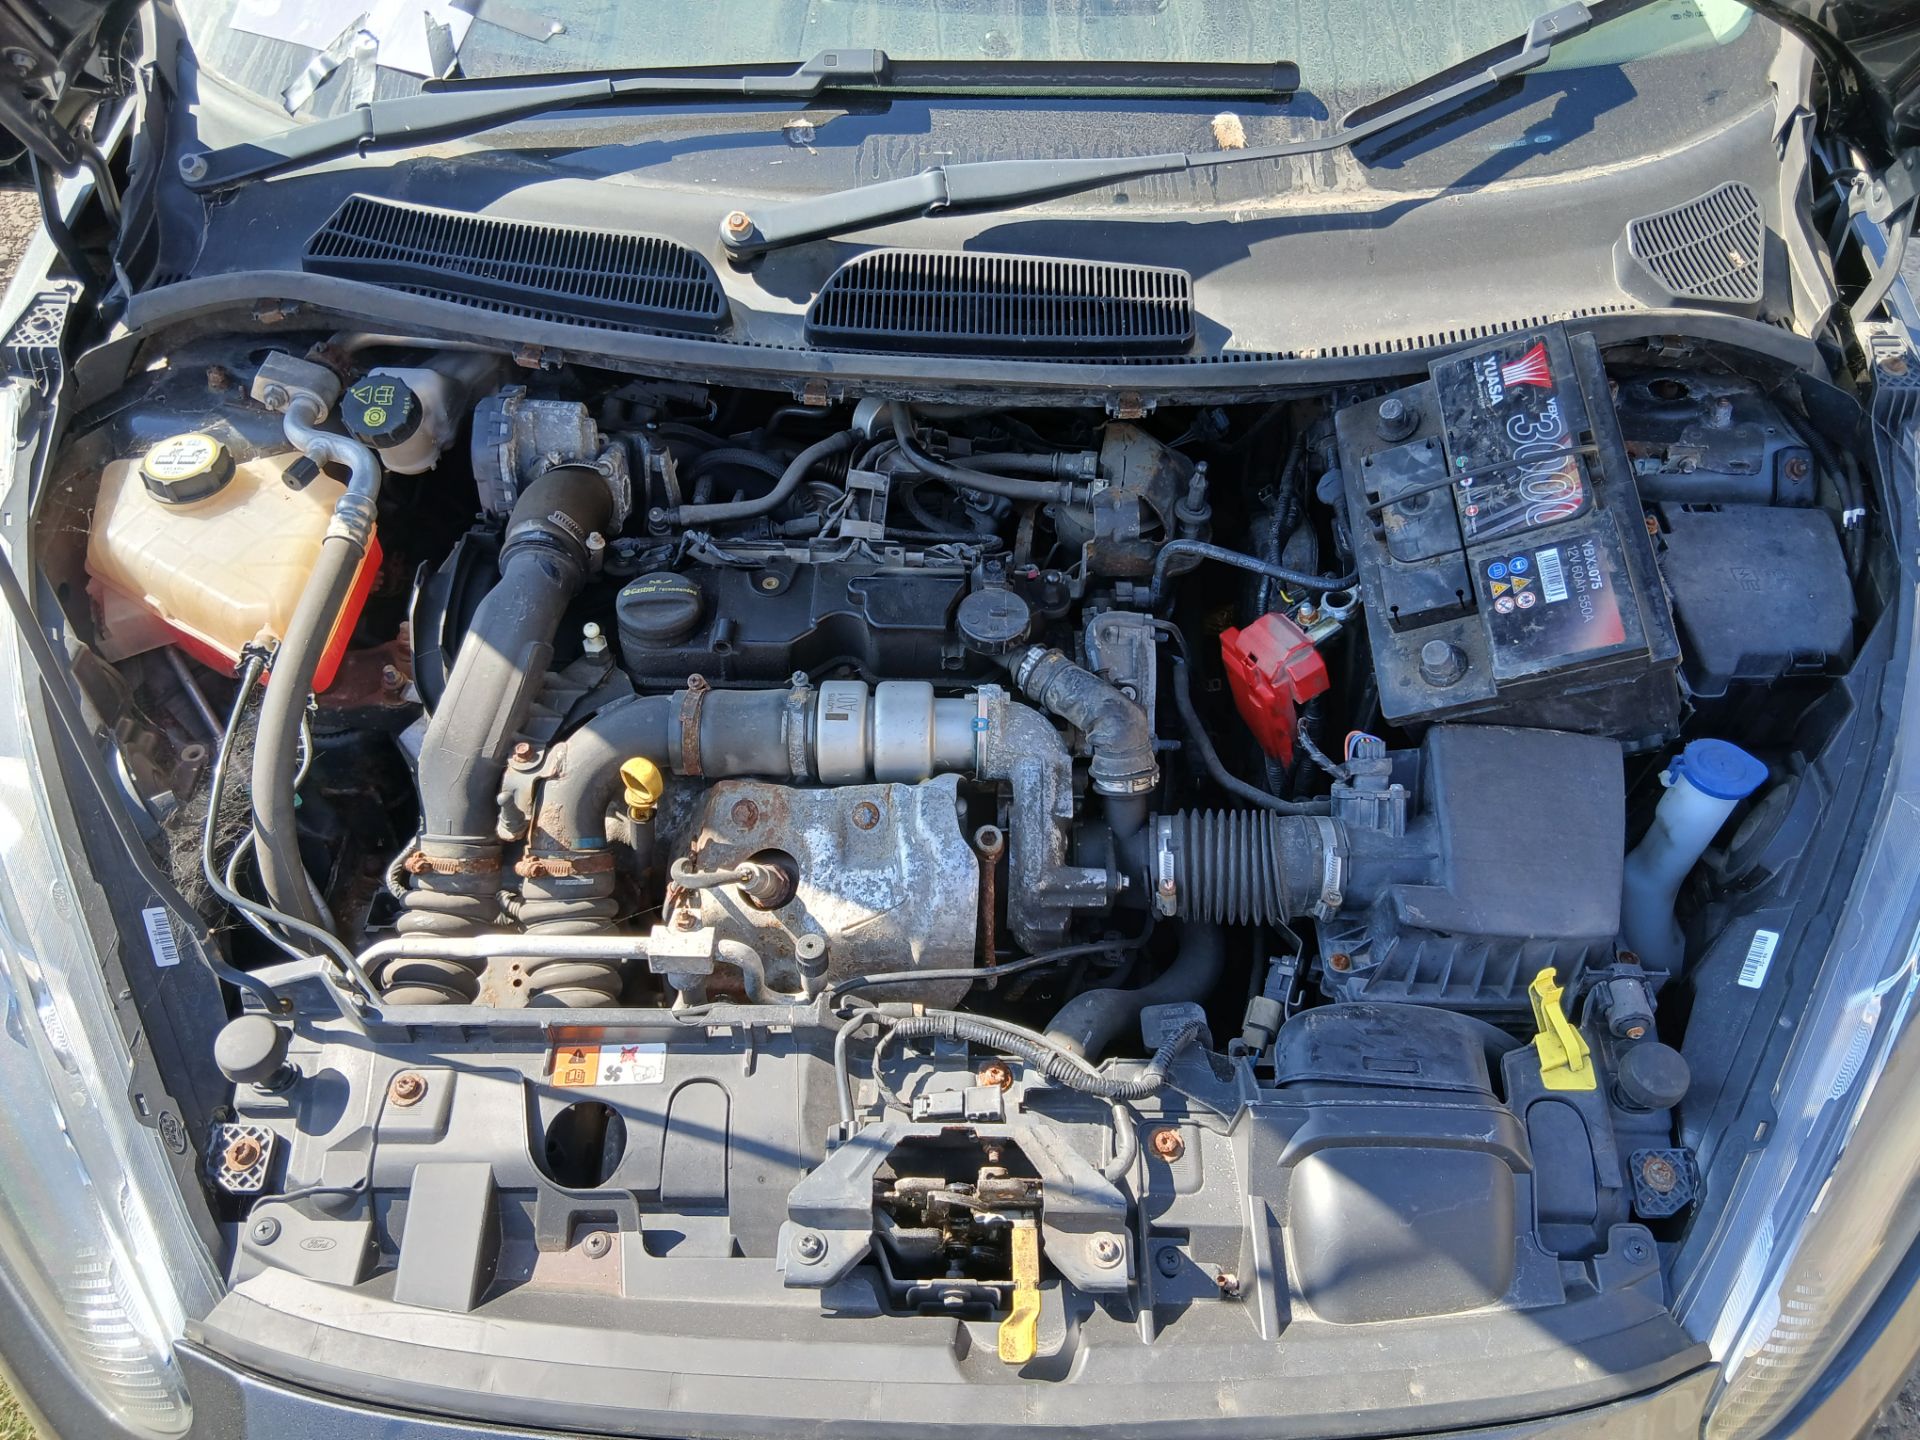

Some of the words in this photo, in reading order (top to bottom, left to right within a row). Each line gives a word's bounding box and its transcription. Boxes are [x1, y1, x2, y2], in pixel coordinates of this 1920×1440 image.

[1483, 356, 1504, 406] YUASA
[1546, 397, 1560, 420] YBX
[1567, 545, 1582, 562] 12V
[1582, 540, 1602, 590] YBX3075
[1571, 565, 1587, 593] 60Ah
[1578, 594, 1595, 624] 550A
